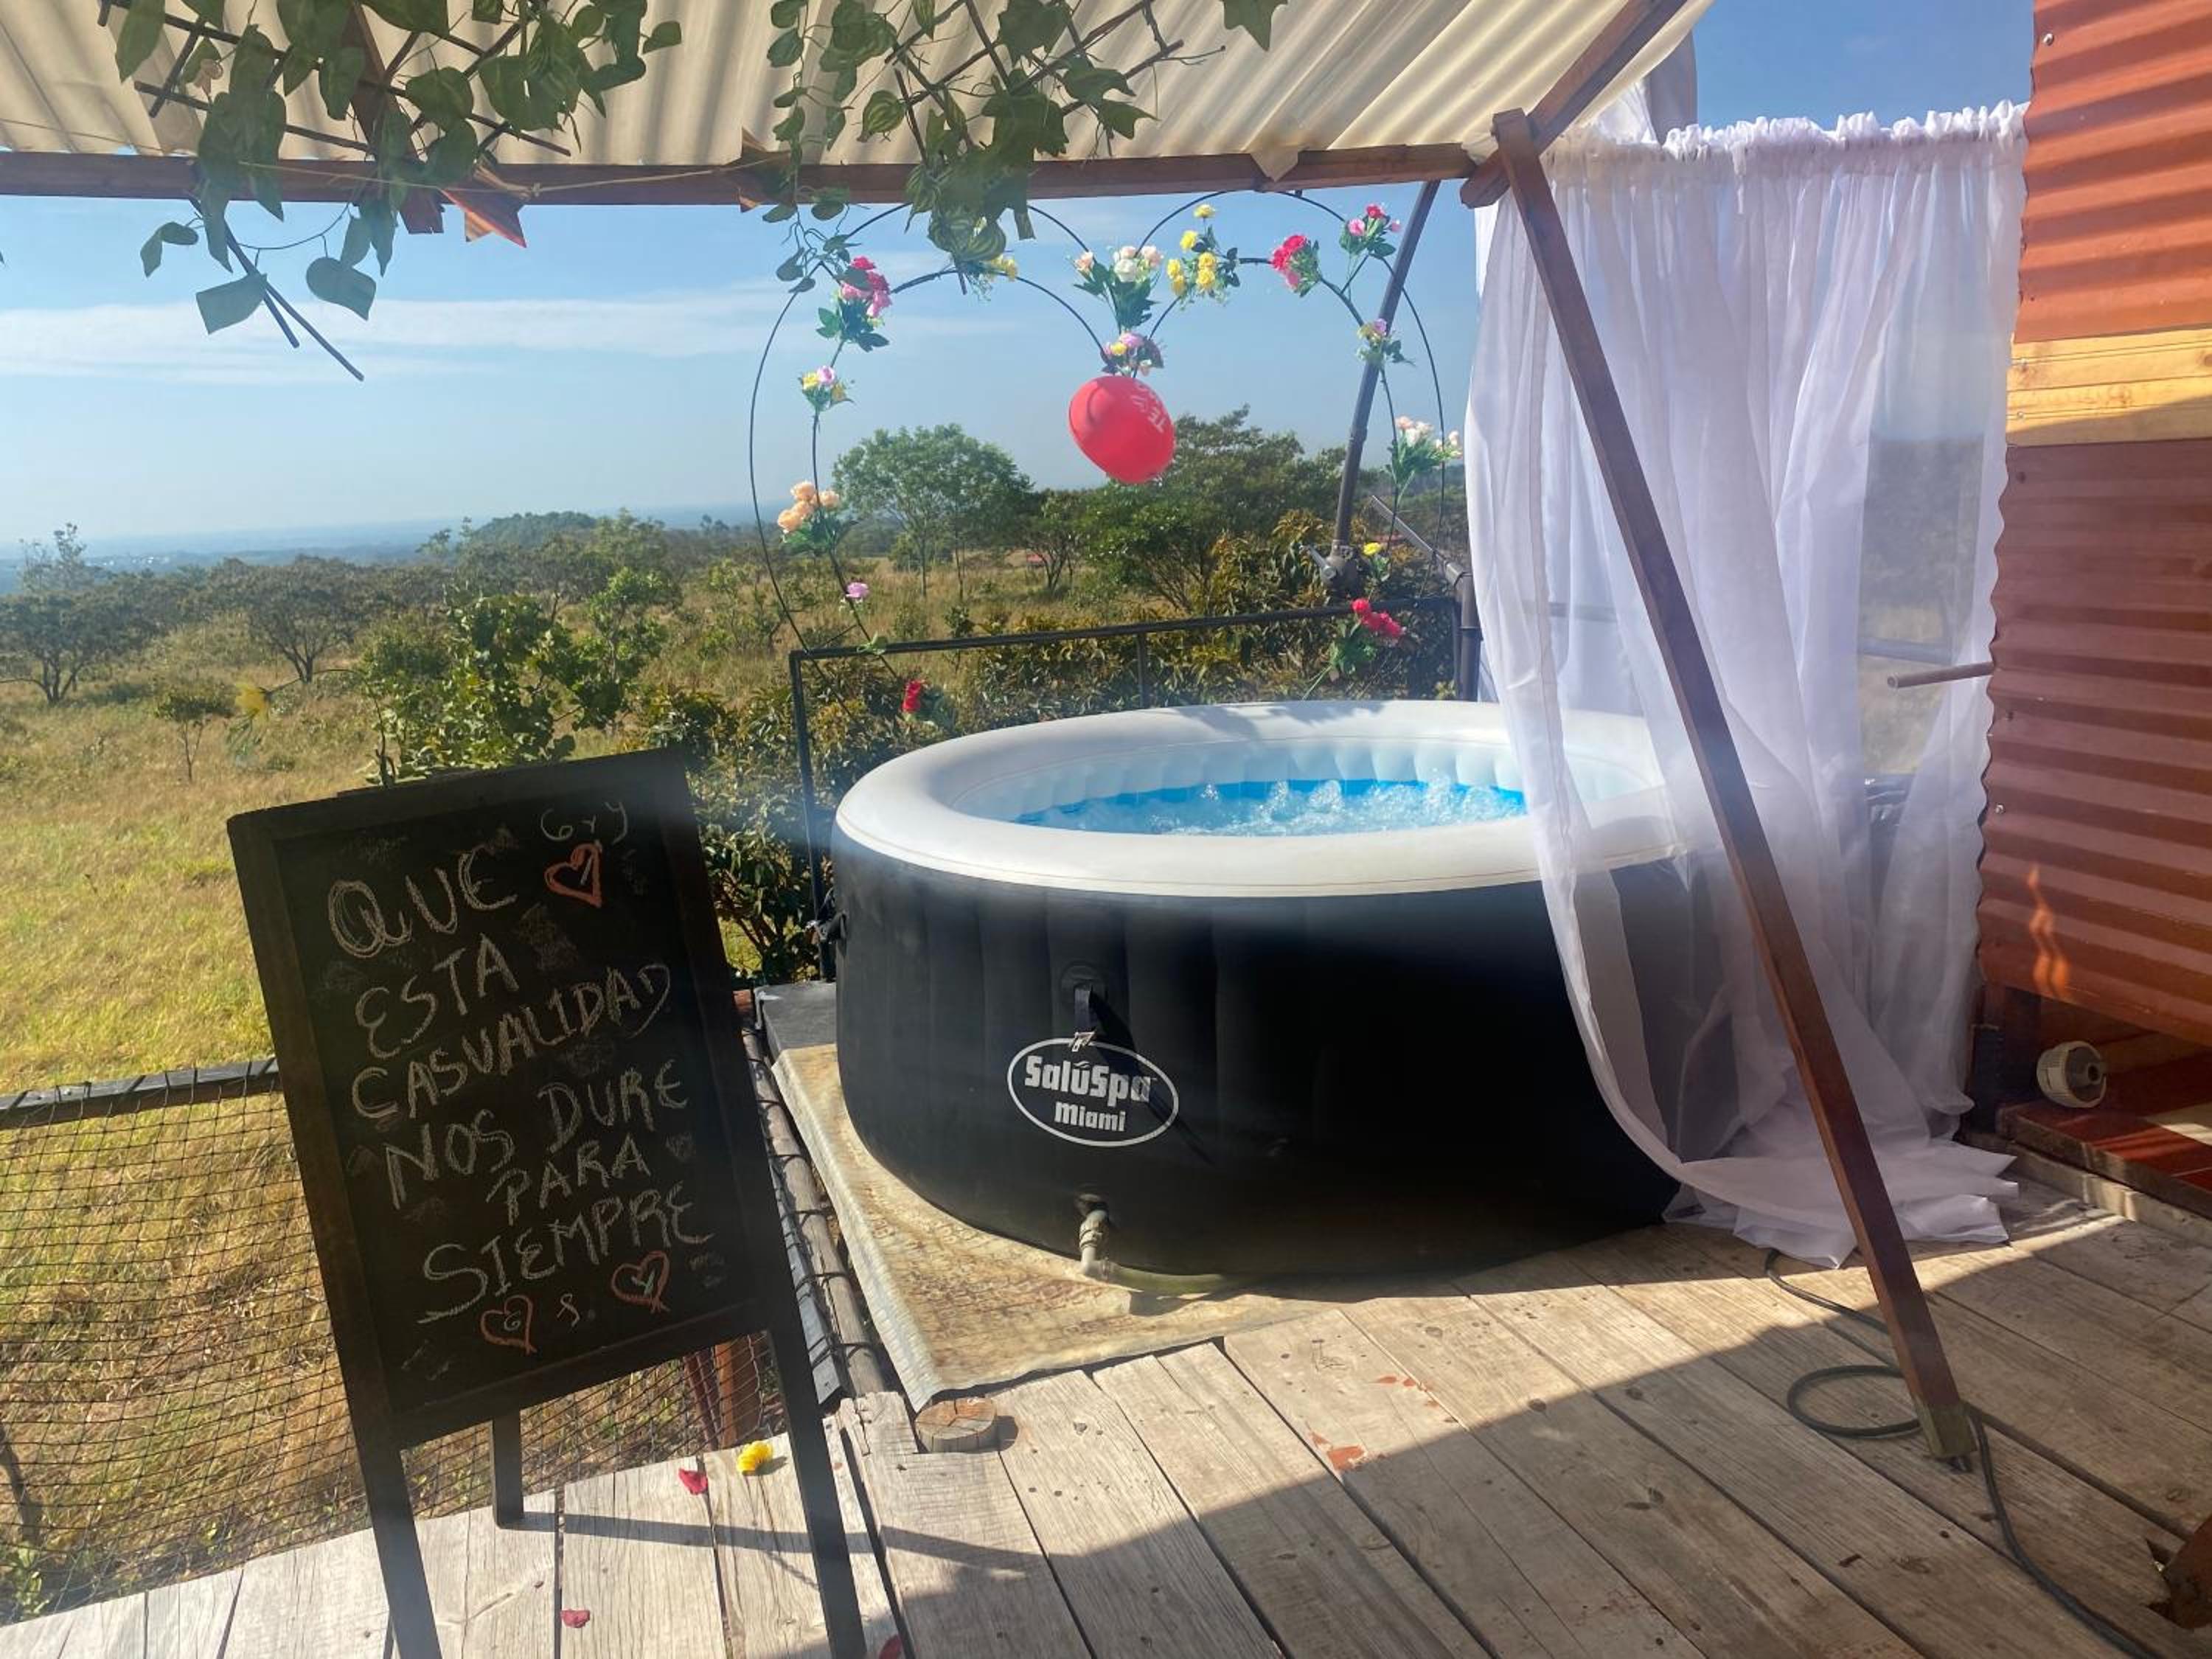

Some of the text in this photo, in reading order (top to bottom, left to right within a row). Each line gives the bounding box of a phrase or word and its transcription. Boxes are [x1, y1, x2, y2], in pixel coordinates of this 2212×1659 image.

[328, 844, 516, 958] QUE
[355, 933, 519, 1059] ESTA
[386, 1059, 689, 1209] NOS DURE
[1054, 1102, 1126, 1132] Miami
[486, 1133, 651, 1225] PARA
[417, 1180, 715, 1324] SIEMPRE
